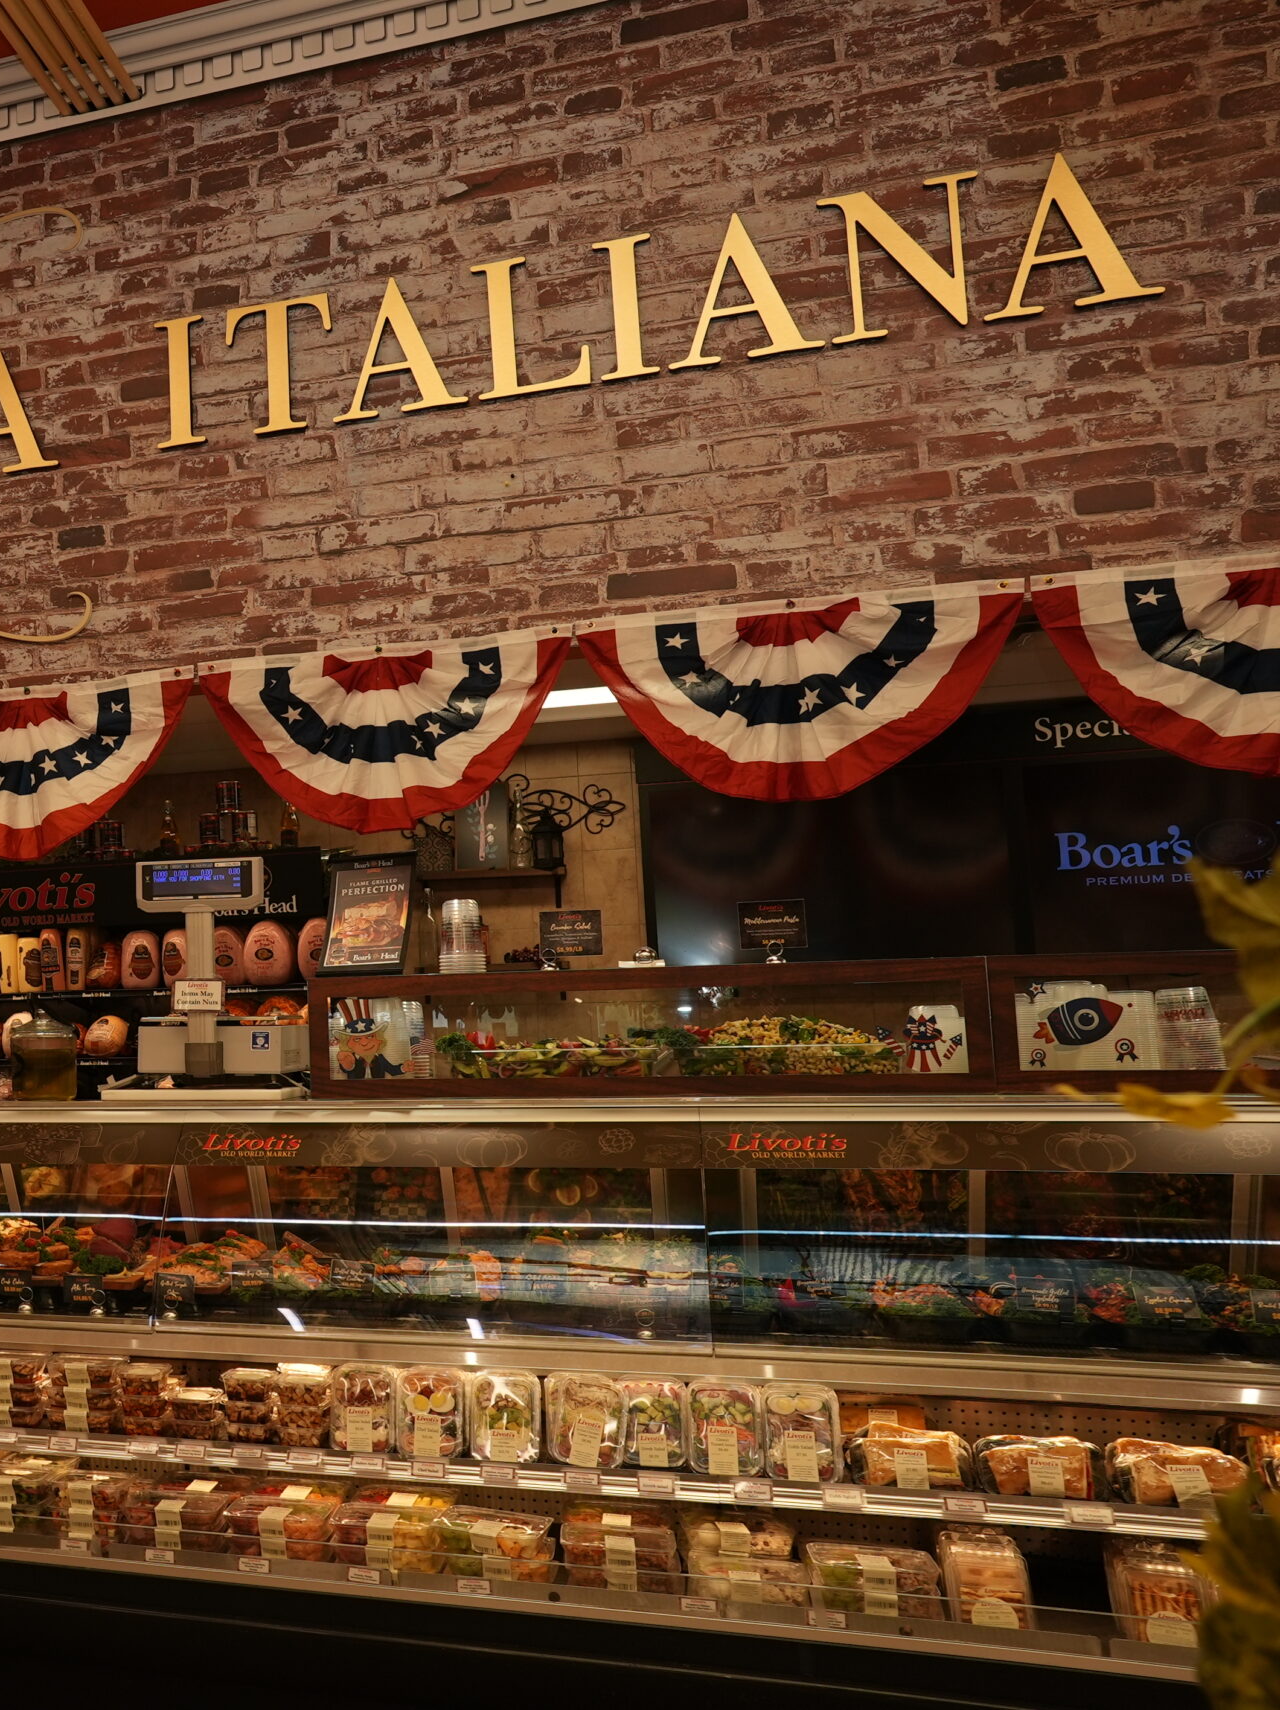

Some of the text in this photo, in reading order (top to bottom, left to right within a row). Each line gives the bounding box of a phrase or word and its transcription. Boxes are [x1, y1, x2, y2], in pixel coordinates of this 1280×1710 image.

[153, 152, 1166, 451] ITALIANA
[1033, 717, 1131, 748] Speci
[377, 858, 394, 868] Head
[349, 879, 369, 888] FLAME
[1086, 873, 1165, 886] PREMIUM
[341, 882, 406, 896] PERFECTION
[256, 894, 298, 914] Head
[0, 911, 96, 927] OLD WORLD MARKET
[379, 950, 399, 960] Head
[181, 989, 215, 999] Items May
[176, 997, 220, 1007] Contain Nuts
[220, 1150, 297, 1158] OLD WORLD MARKET
[751, 1151, 846, 1160] OLD WORLD MARKET
